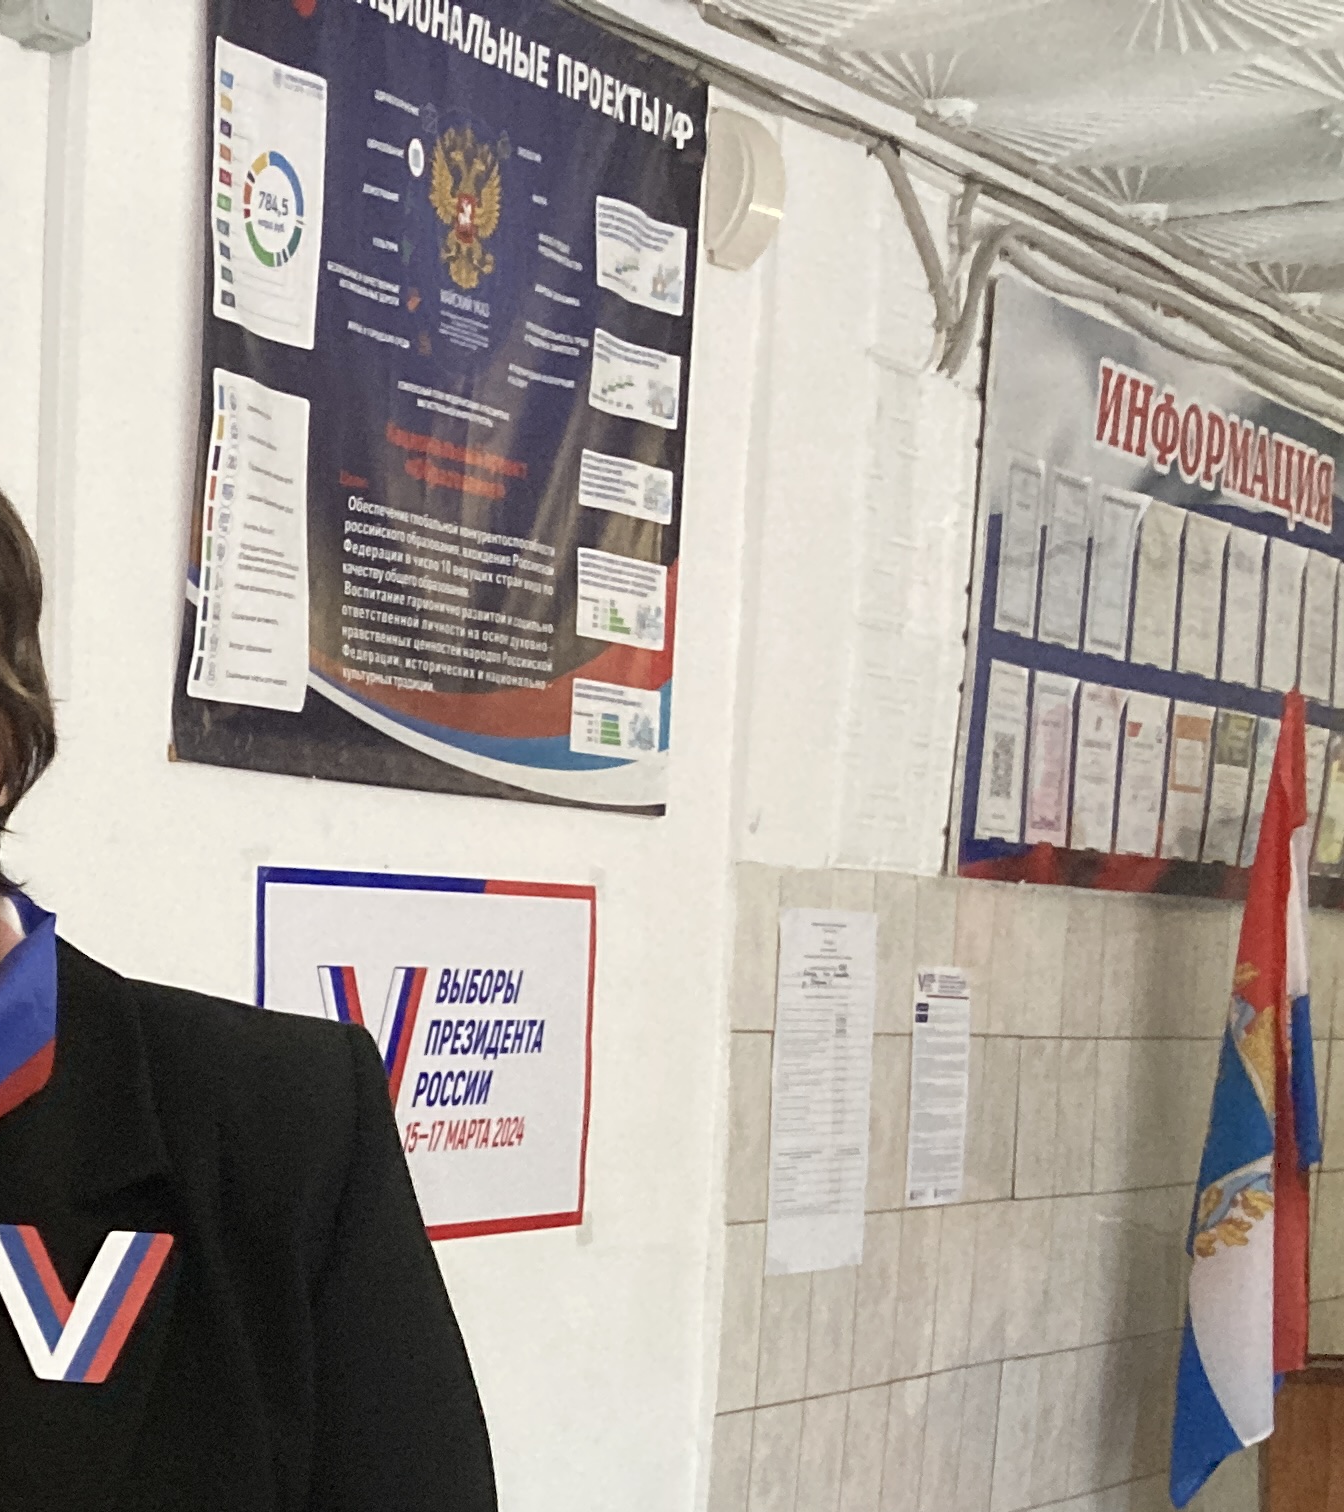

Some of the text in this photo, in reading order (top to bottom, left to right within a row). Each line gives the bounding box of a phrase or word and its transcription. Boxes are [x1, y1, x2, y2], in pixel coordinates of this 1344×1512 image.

[355, 0, 551, 89] ЦИОНАЛЬНЫЕ
[557, 53, 660, 135] ПРОЕКТЫ
[258, 190, 289, 218] 784,5
[1094, 361, 1336, 531] ИНФОРМАЦИЯ
[343, 538, 404, 563] Федерации
[441, 559, 452, 574] 10
[343, 580, 405, 605] Воспитание
[341, 604, 420, 628] ответственной
[435, 968, 524, 1004] ВЫБОРЫ
[424, 1019, 545, 1060] ПРЕЗИДЕНТА
[411, 1070, 494, 1108] РОССИИ
[444, 1118, 492, 1151] МАРТА
[492, 1116, 525, 1148] 2024
